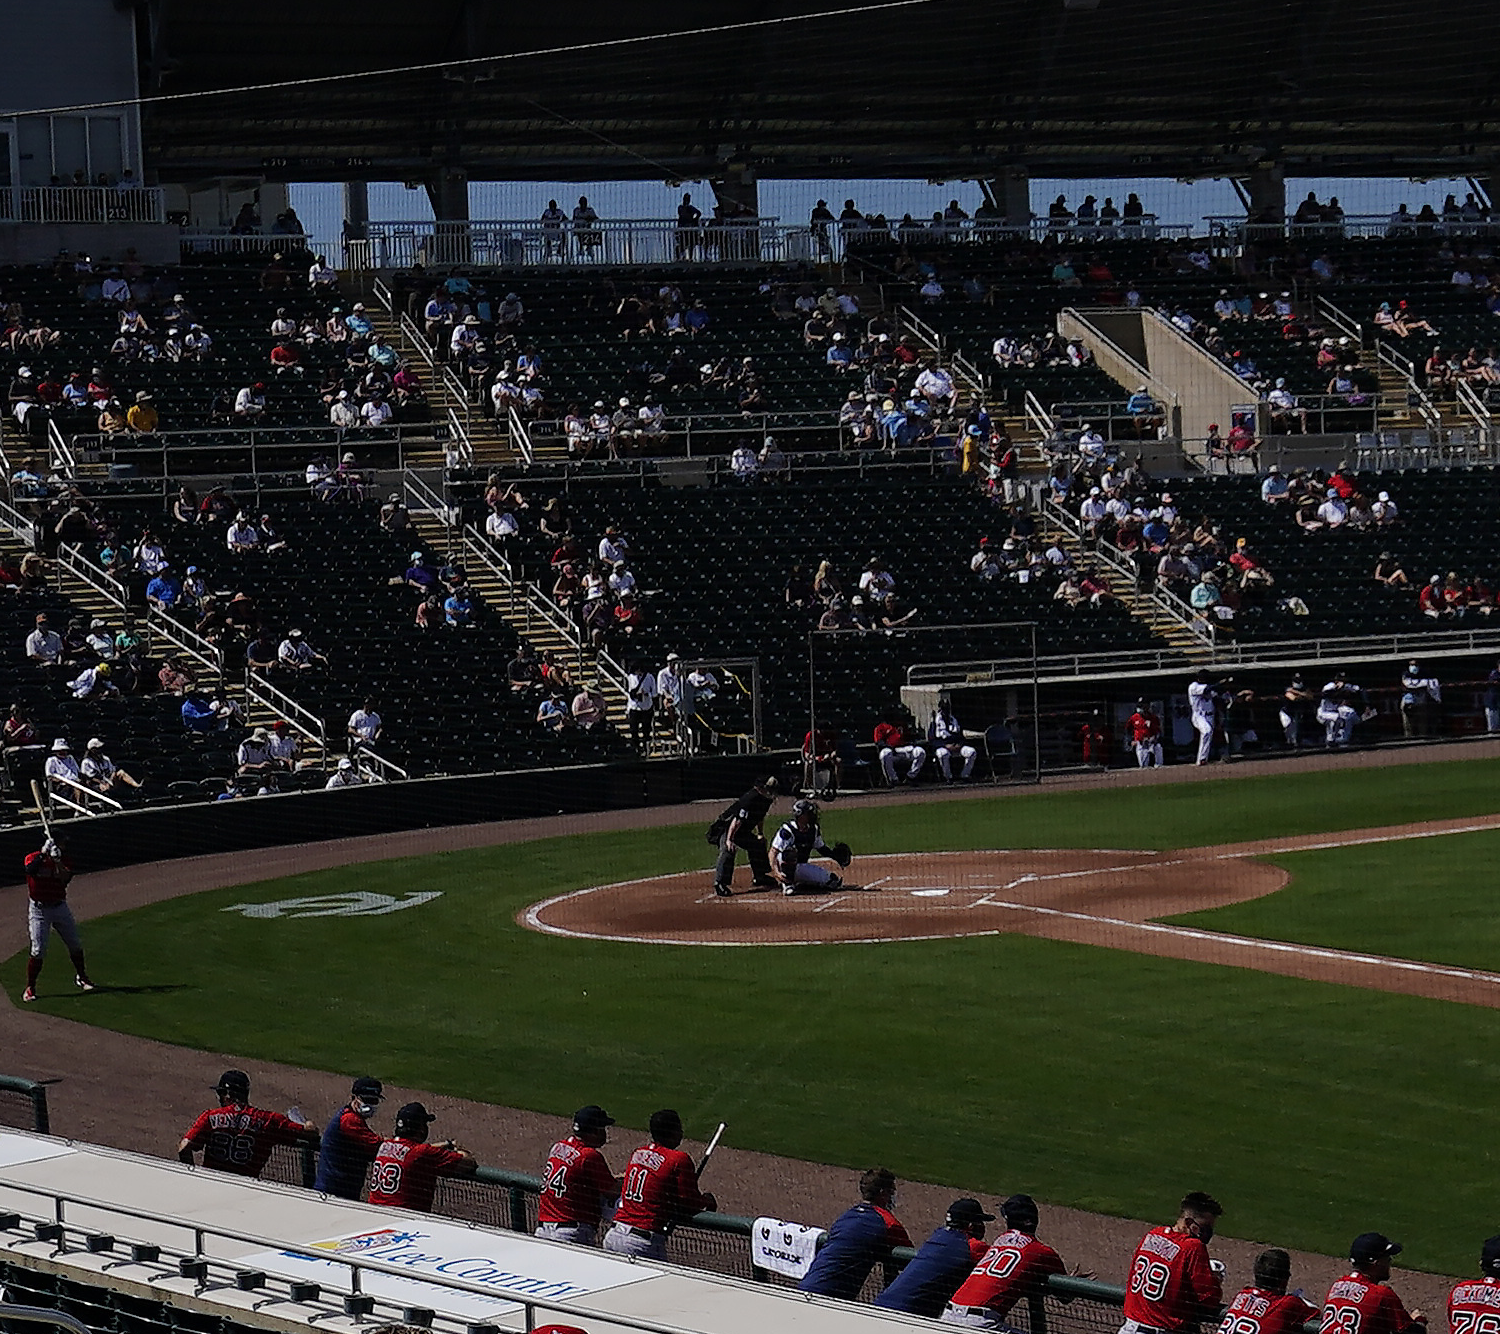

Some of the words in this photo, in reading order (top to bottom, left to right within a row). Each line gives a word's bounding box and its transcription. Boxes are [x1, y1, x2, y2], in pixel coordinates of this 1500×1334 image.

[624, 1166, 650, 1203] 11
[368, 1244, 441, 1270] Lee
[437, 1257, 591, 1300] County
[1131, 1254, 1170, 1302] 39
